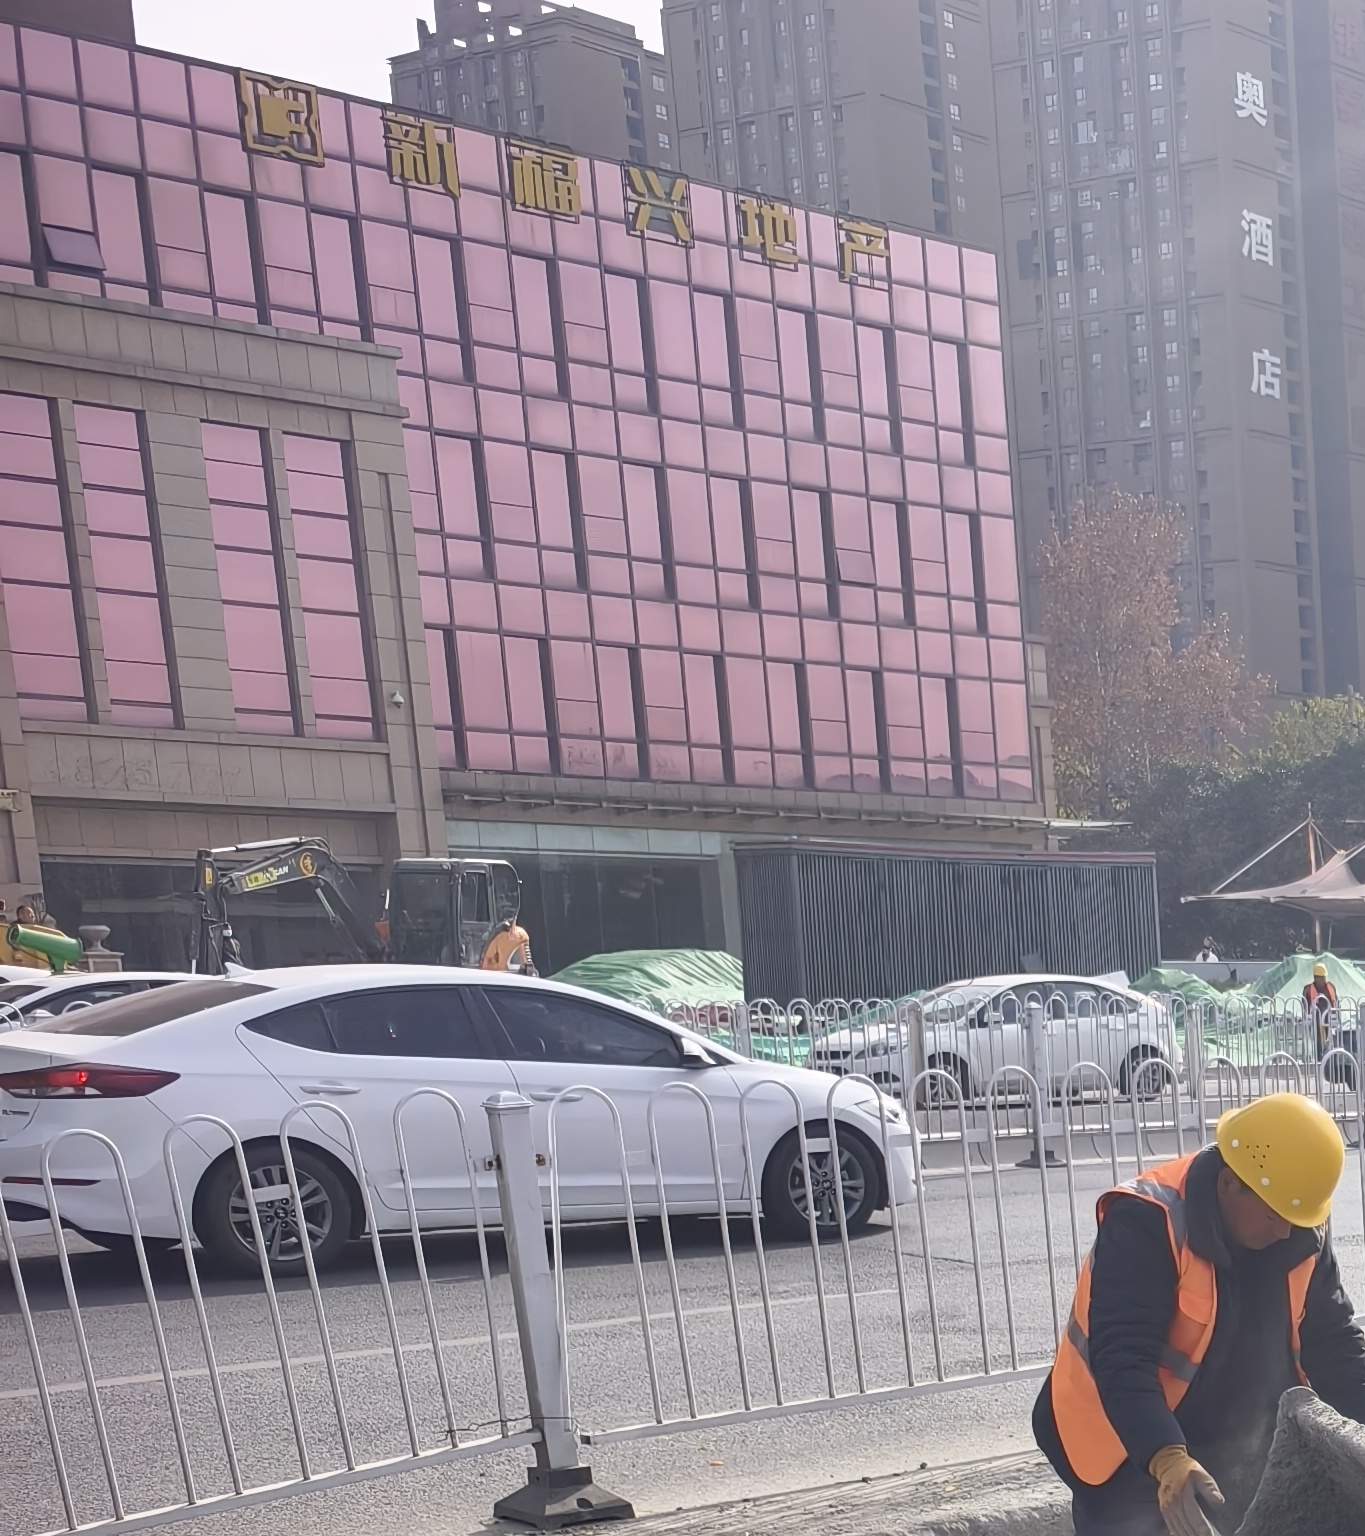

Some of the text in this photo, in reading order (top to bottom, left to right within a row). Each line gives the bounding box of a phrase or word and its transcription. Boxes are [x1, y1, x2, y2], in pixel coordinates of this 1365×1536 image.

[384, 112, 890, 284] 新福兴地产
[1233, 71, 1282, 400] 奥酒店
